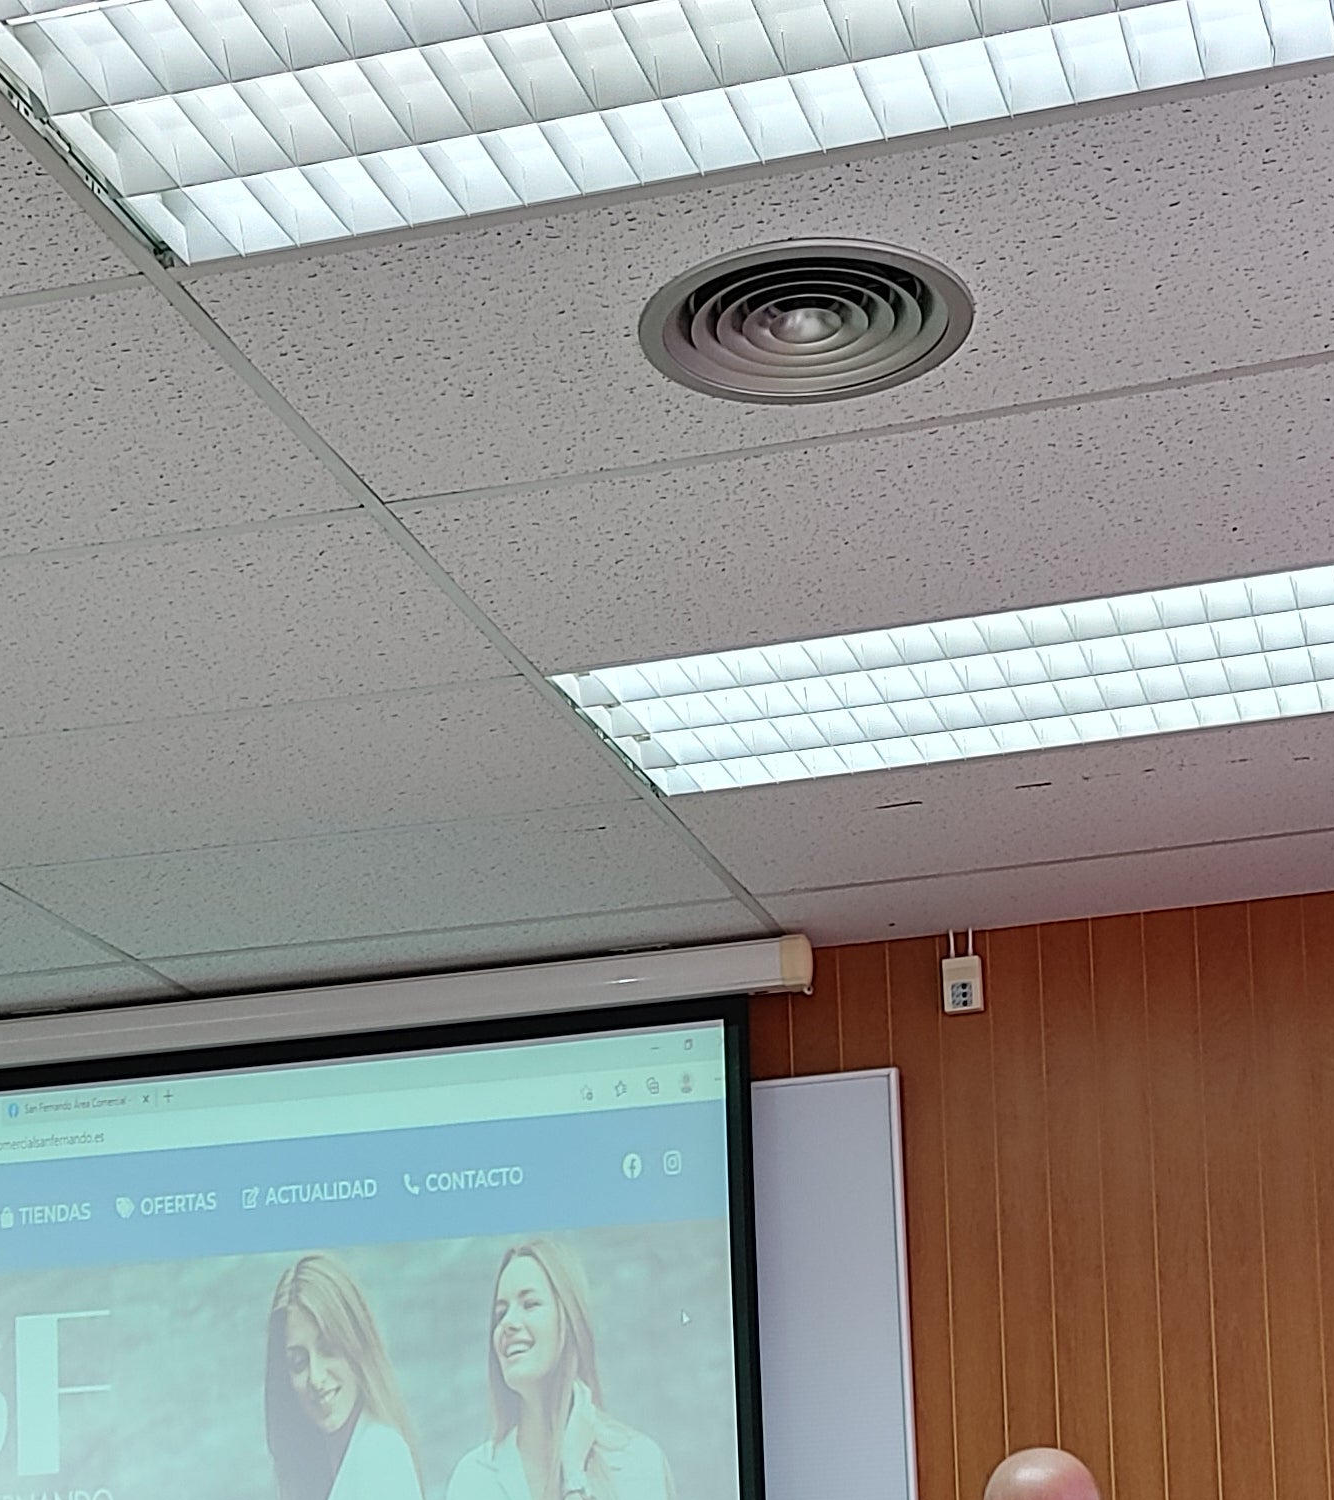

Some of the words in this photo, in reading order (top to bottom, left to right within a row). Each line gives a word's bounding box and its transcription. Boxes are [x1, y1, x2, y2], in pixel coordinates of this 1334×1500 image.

[19, 1203, 91, 1226] TIENDAS
[140, 1192, 217, 1216] OFERTAS
[265, 1179, 378, 1206] ACTUALIDAD
[425, 1166, 524, 1193] CONTACTO
